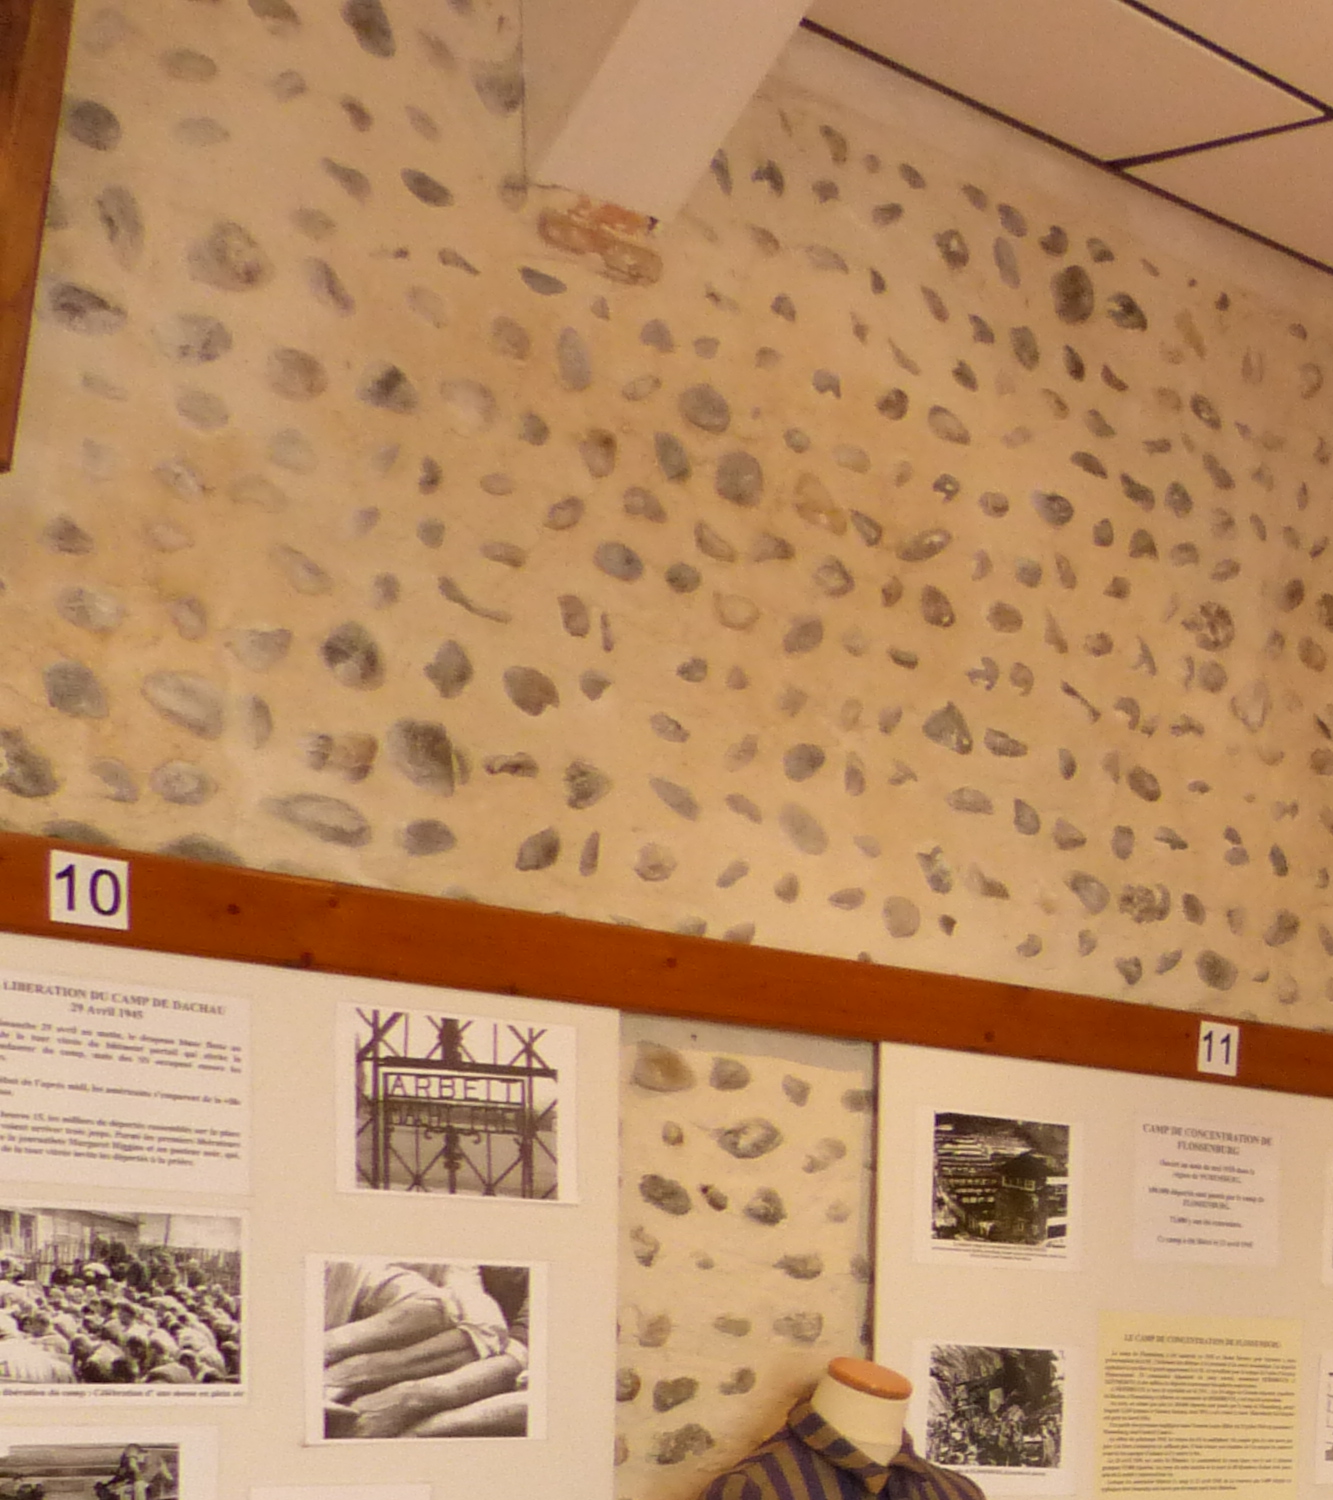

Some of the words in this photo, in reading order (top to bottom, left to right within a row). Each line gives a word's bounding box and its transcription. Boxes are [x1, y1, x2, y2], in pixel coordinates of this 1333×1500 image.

[54, 862, 122, 917] 10
[152, 997, 170, 1009] DE
[173, 1000, 227, 1015] DACHAU
[1201, 1030, 1232, 1065] 11
[390, 1073, 519, 1104] ARBEIT
